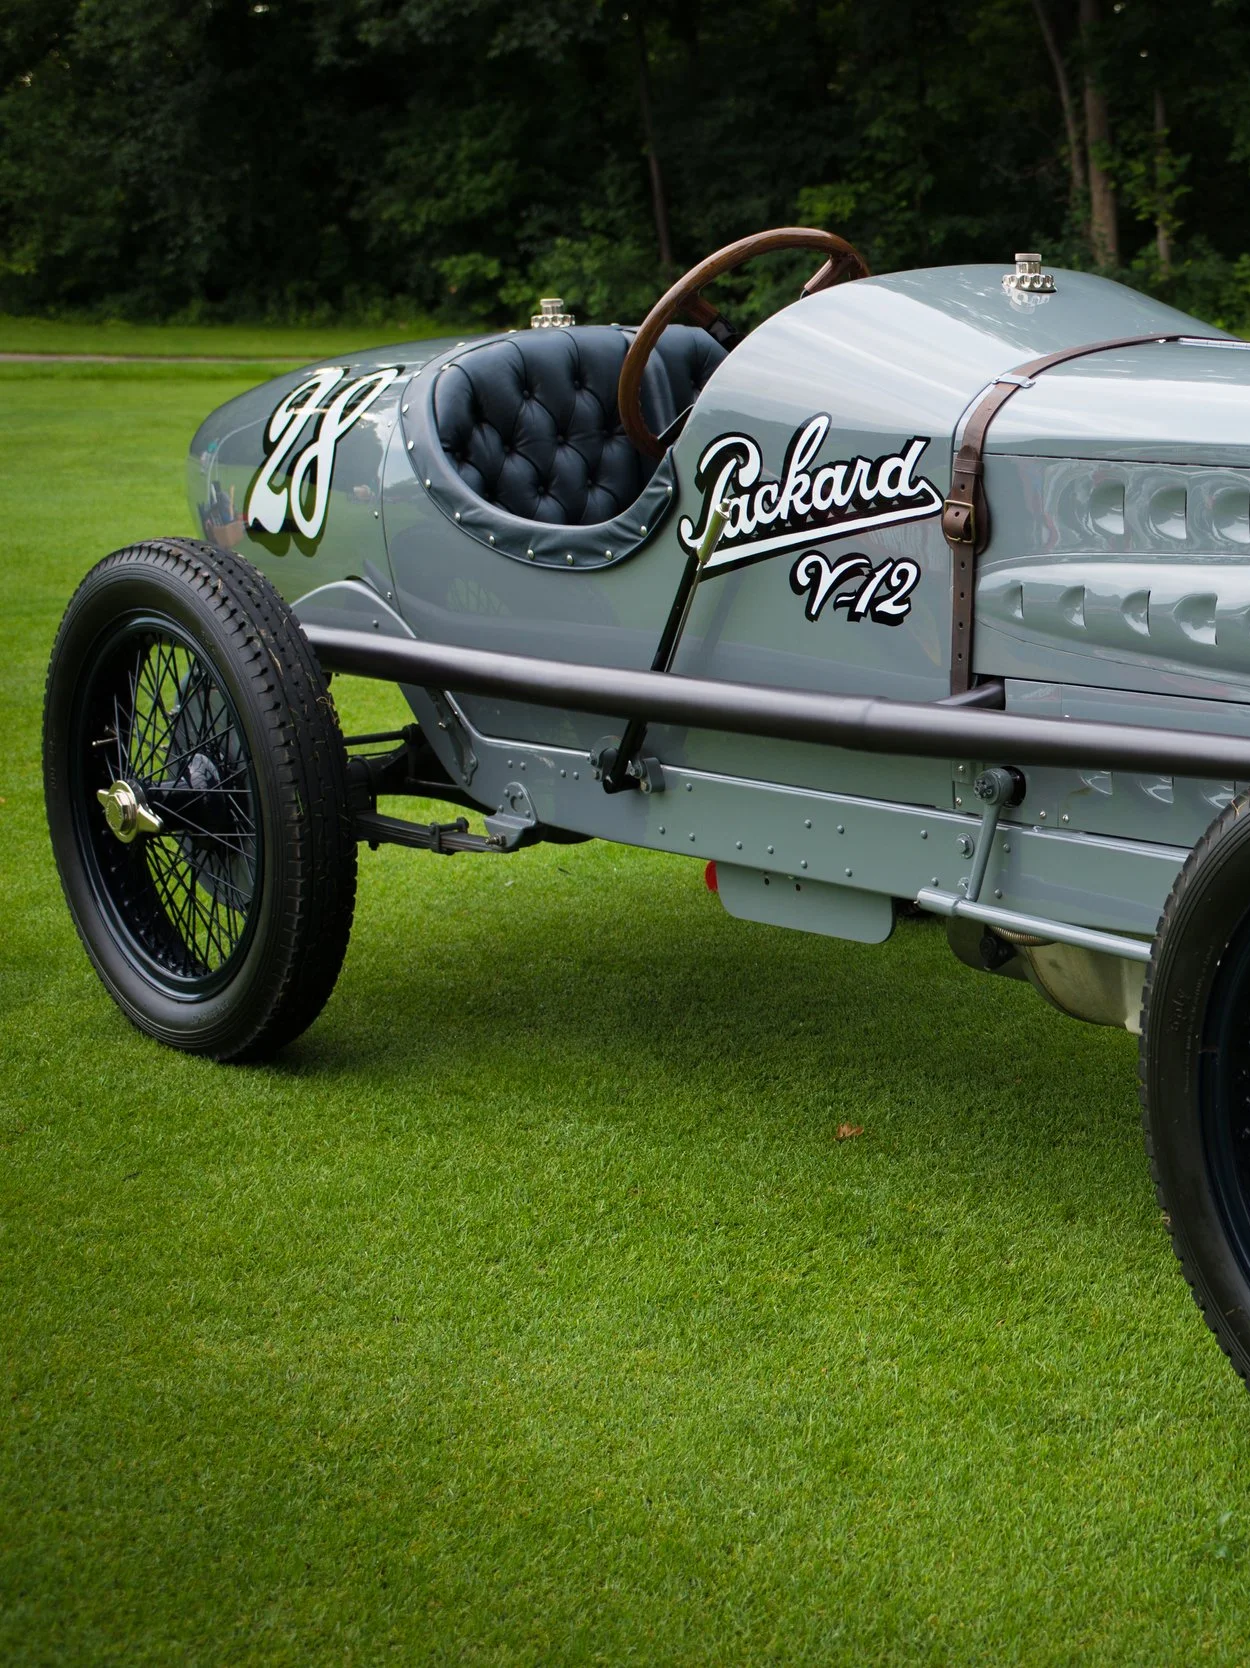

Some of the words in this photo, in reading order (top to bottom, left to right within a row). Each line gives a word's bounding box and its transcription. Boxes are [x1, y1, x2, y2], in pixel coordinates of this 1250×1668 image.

[246, 367, 402, 546] 28
[678, 412, 943, 571] Packard
[791, 551, 920, 623] V-12
